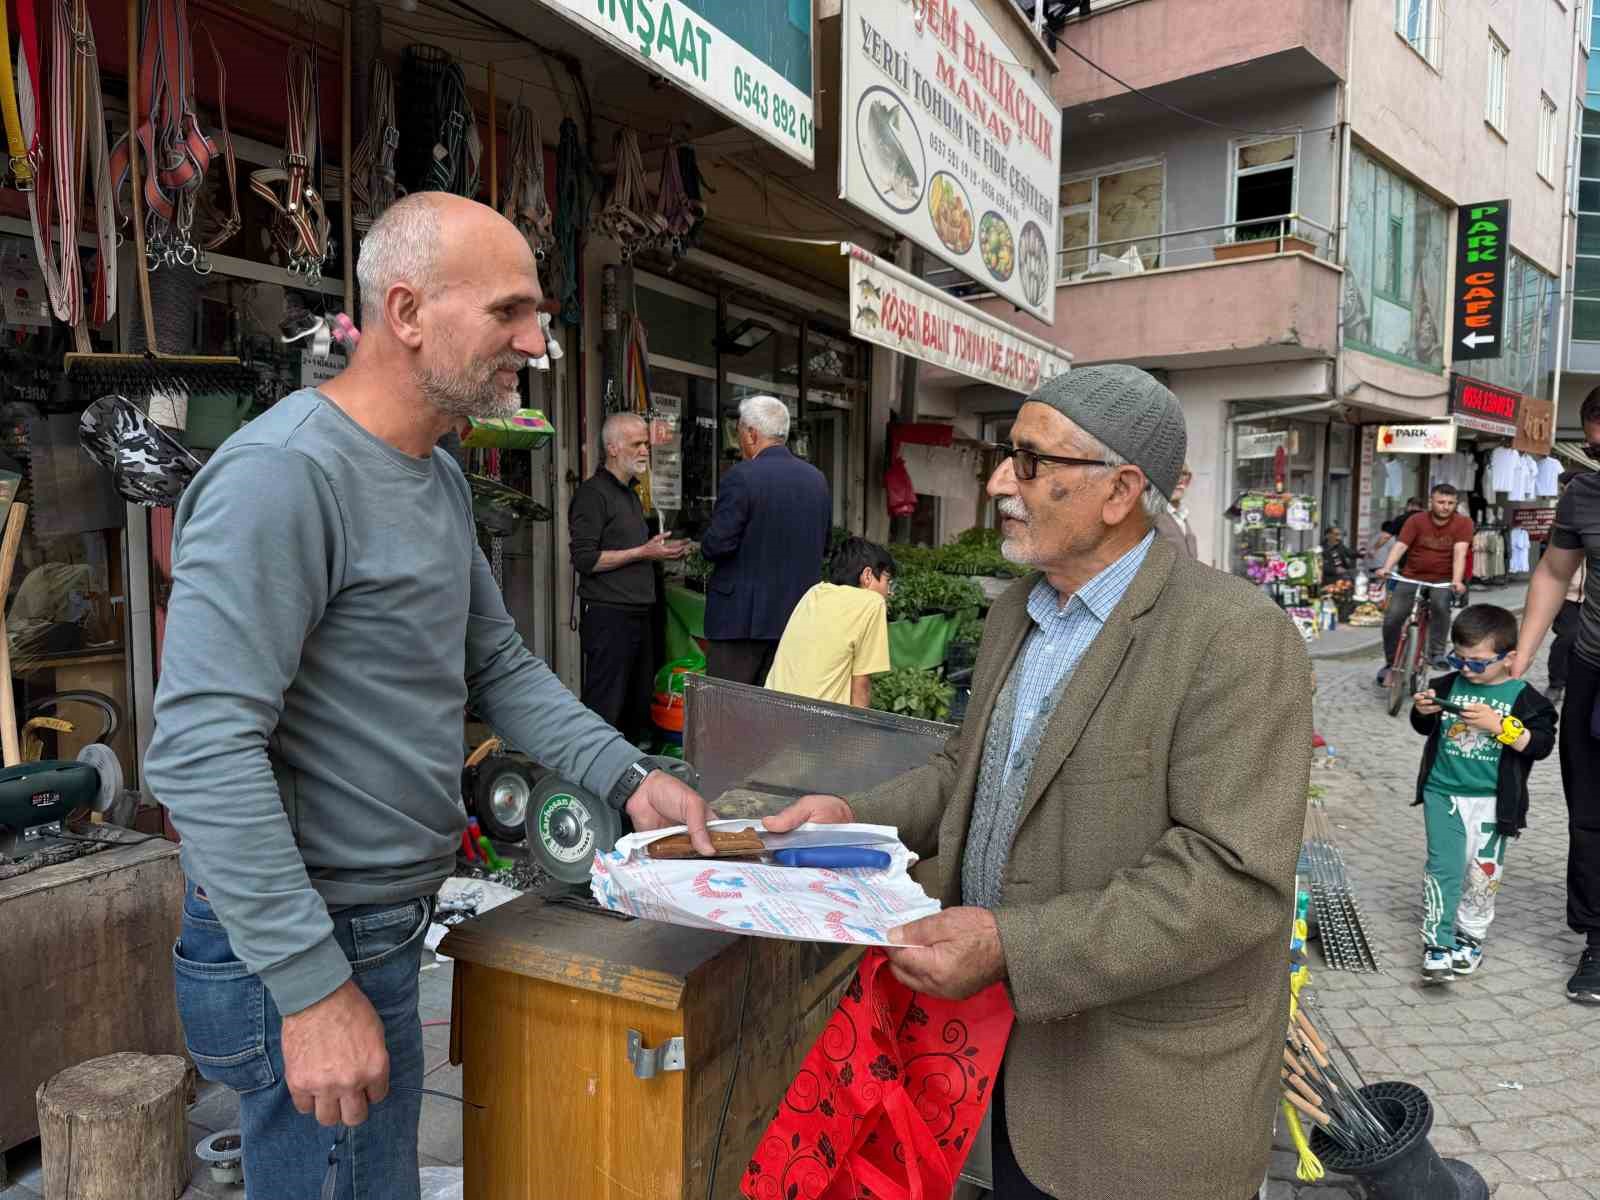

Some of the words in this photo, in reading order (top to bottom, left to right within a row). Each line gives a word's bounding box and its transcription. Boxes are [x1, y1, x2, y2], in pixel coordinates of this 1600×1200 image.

[597, 0, 711, 82] NŞAAT
[734, 65, 769, 120] 0543
[773, 93, 796, 139] 892
[860, 15, 909, 90] YERLİ
[912, 66, 962, 140] TOHUM
[965, 119, 981, 156] VE
[936, 51, 1012, 146] MANAV
[1466, 206, 1499, 263] PARK
[1463, 271, 1496, 328] CAFE
[1395, 428, 1427, 438] PARK
